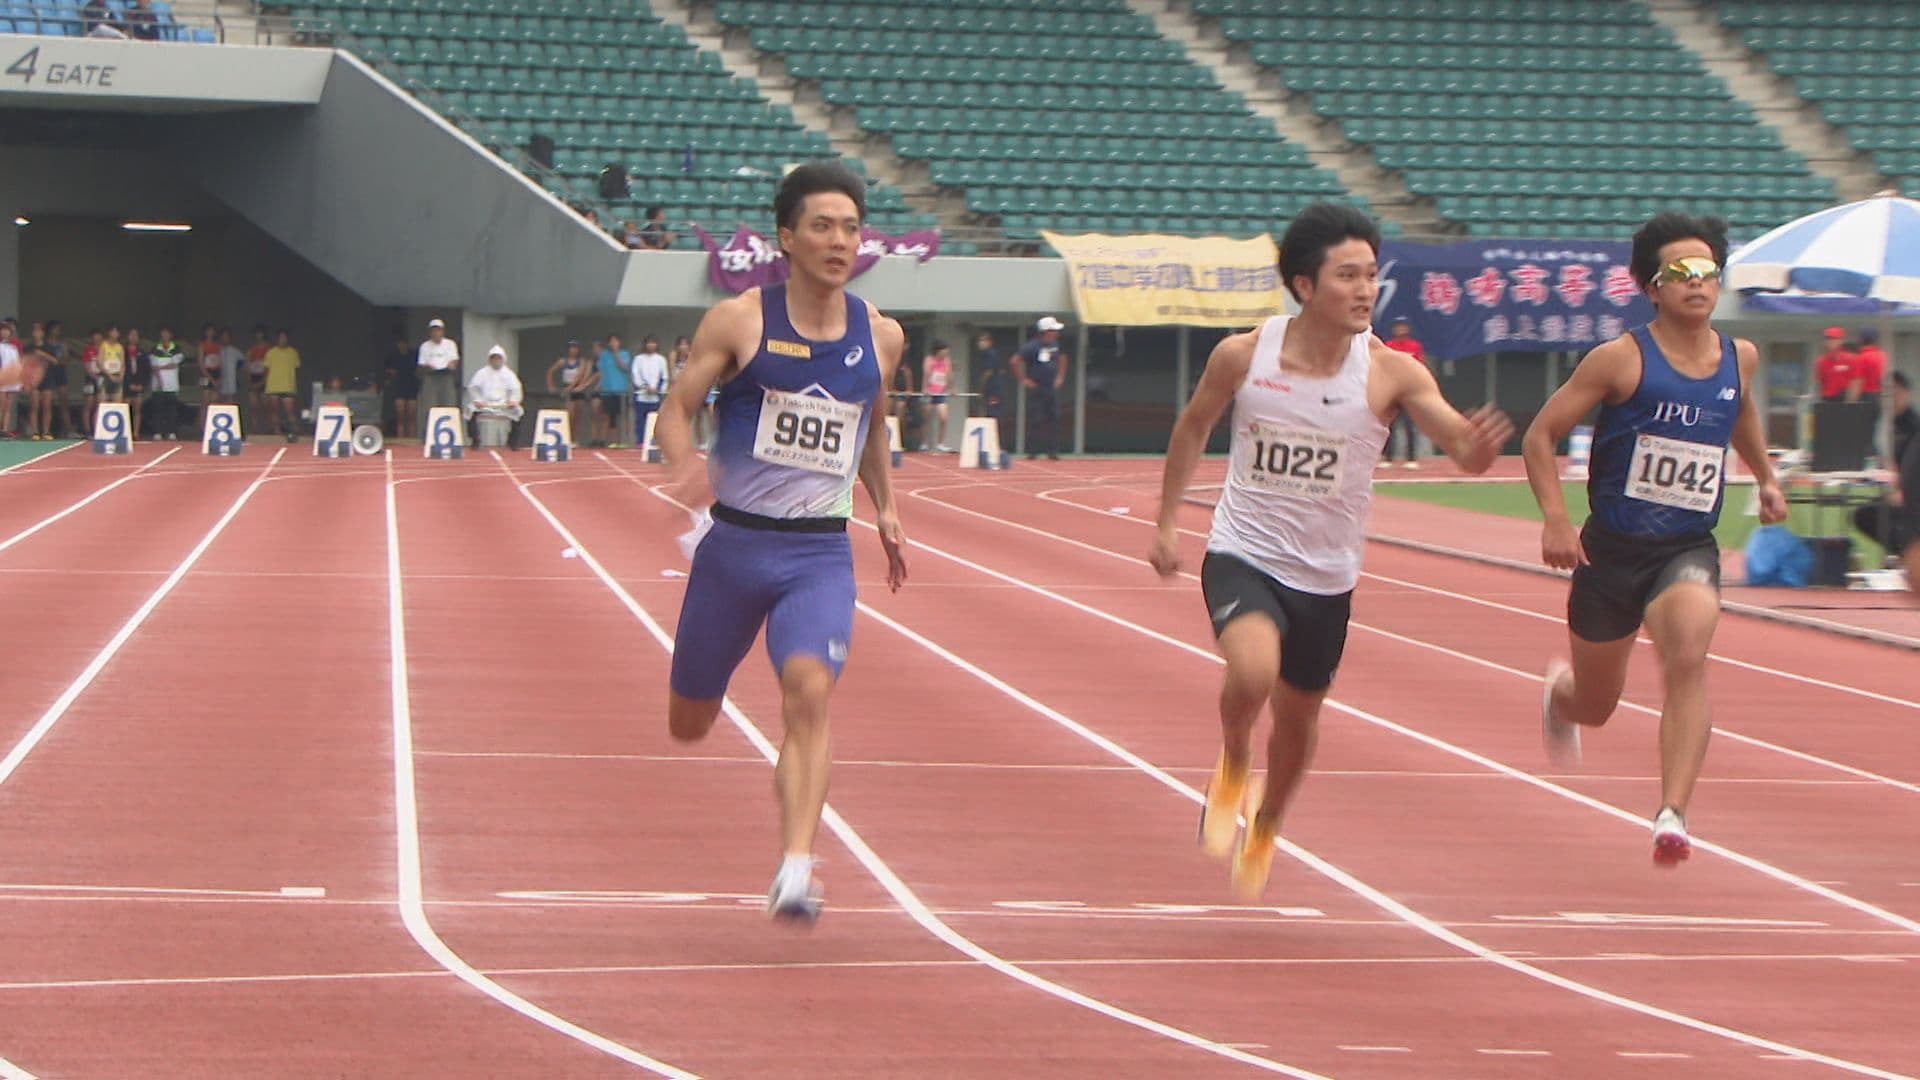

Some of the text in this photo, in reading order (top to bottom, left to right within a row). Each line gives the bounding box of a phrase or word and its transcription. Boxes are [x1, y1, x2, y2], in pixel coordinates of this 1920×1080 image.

[5, 46, 117, 87] 4 GATE
[102, 410, 125, 441] 9
[211, 412, 234, 446] 8
[323, 415, 345, 447] 7
[1653, 401, 1701, 427] IPU
[433, 415, 455, 449] 6
[543, 418, 563, 449] 5
[774, 411, 844, 454] 995
[970, 427, 985, 453] 1
[1252, 439, 1338, 481] 1022
[1638, 453, 1716, 494] 1042
